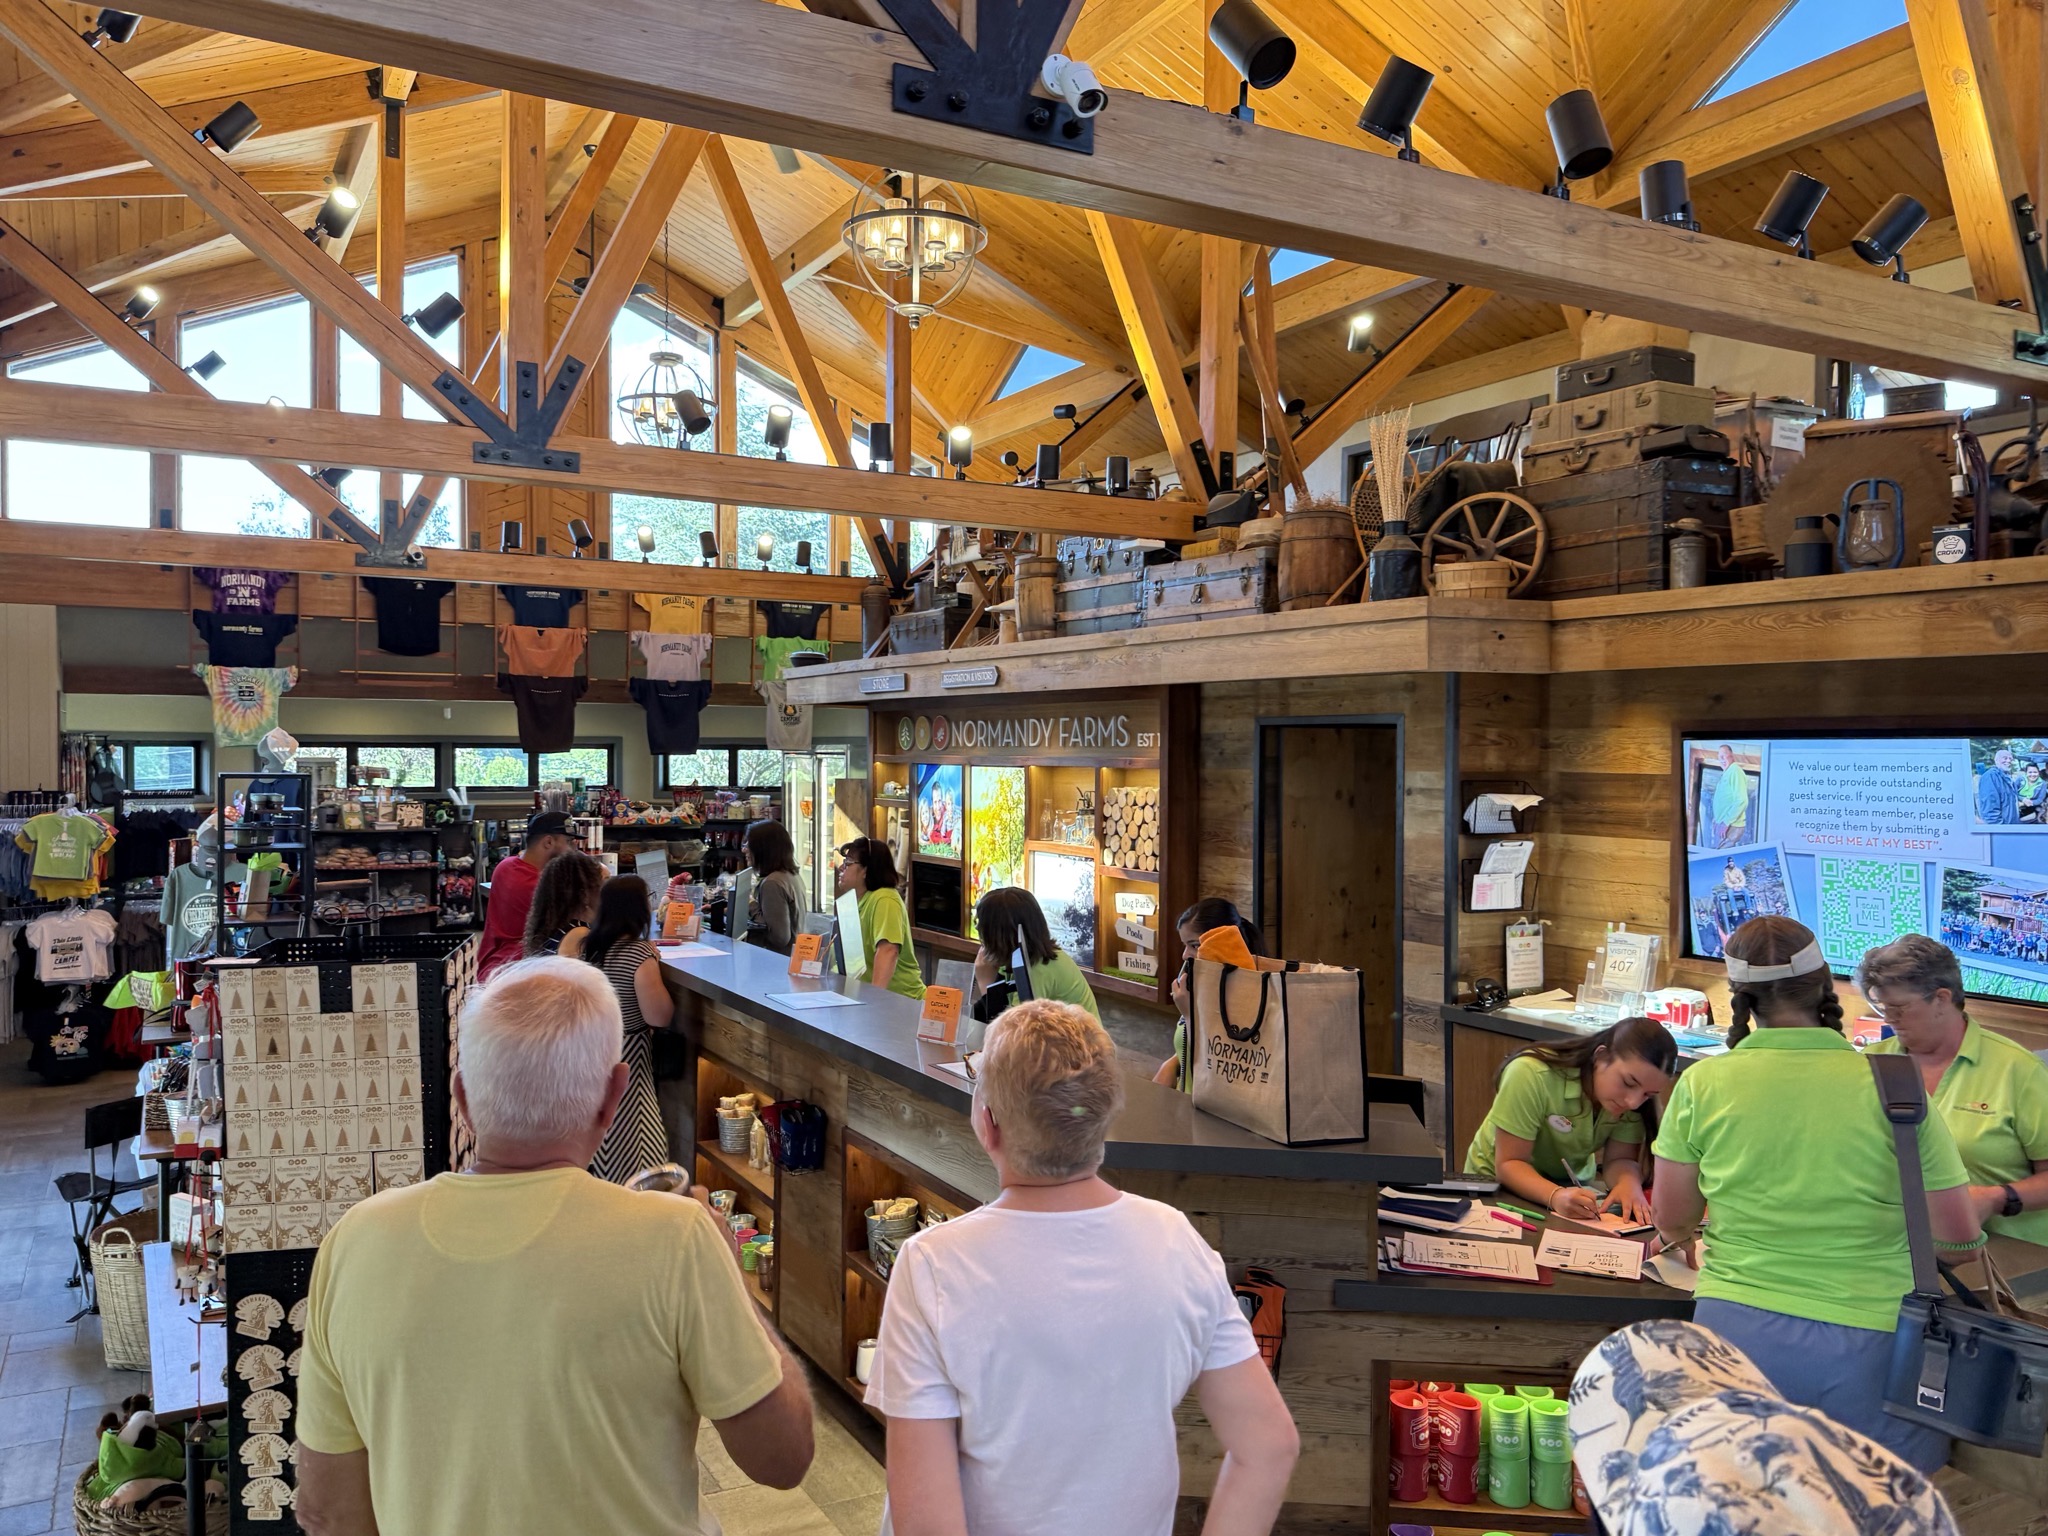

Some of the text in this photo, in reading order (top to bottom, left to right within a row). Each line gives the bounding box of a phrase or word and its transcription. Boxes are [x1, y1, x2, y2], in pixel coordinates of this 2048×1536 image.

[1936, 546, 1965, 556] CROWN
[221, 574, 266, 589] NORMANDY
[237, 587, 250, 597] N
[226, 597, 260, 606] FARMS
[872, 677, 890, 690] STORE
[943, 672, 971, 683] REGISTRATION
[975, 671, 993, 681] VISITORS
[951, 718, 1055, 748] NORMANDY
[1059, 715, 1131, 748] FARMS
[1137, 732, 1155, 748] EST
[1788, 761, 1953, 773] We value our team members and
[1798, 776, 1942, 791] strive to provide outstanding
[1789, 791, 1954, 805] guest service. If you encountered
[1803, 806, 1842, 818] amazing
[1844, 806, 1869, 817] team
[1872, 808, 1916, 820] member,
[1919, 808, 1954, 821] please
[1795, 821, 1949, 838] recognize them by submitting a
[1801, 834, 1844, 845] "CATCH
[1846, 836, 1863, 846] ME
[1865, 837, 1879, 847] AT
[1882, 838, 1900, 848] MY
[1122, 897, 1151, 910] Dog Park
[1861, 910, 1880, 921] ME
[1126, 926, 1143, 940] Pools
[1609, 947, 1638, 956] VISITOR
[54, 956, 80, 965] CAMPER
[1125, 957, 1151, 973] Fishing
[1609, 960, 1634, 973] 407
[1207, 1035, 1272, 1069] NORMANDY
[1216, 1059, 1256, 1084] FARMS
